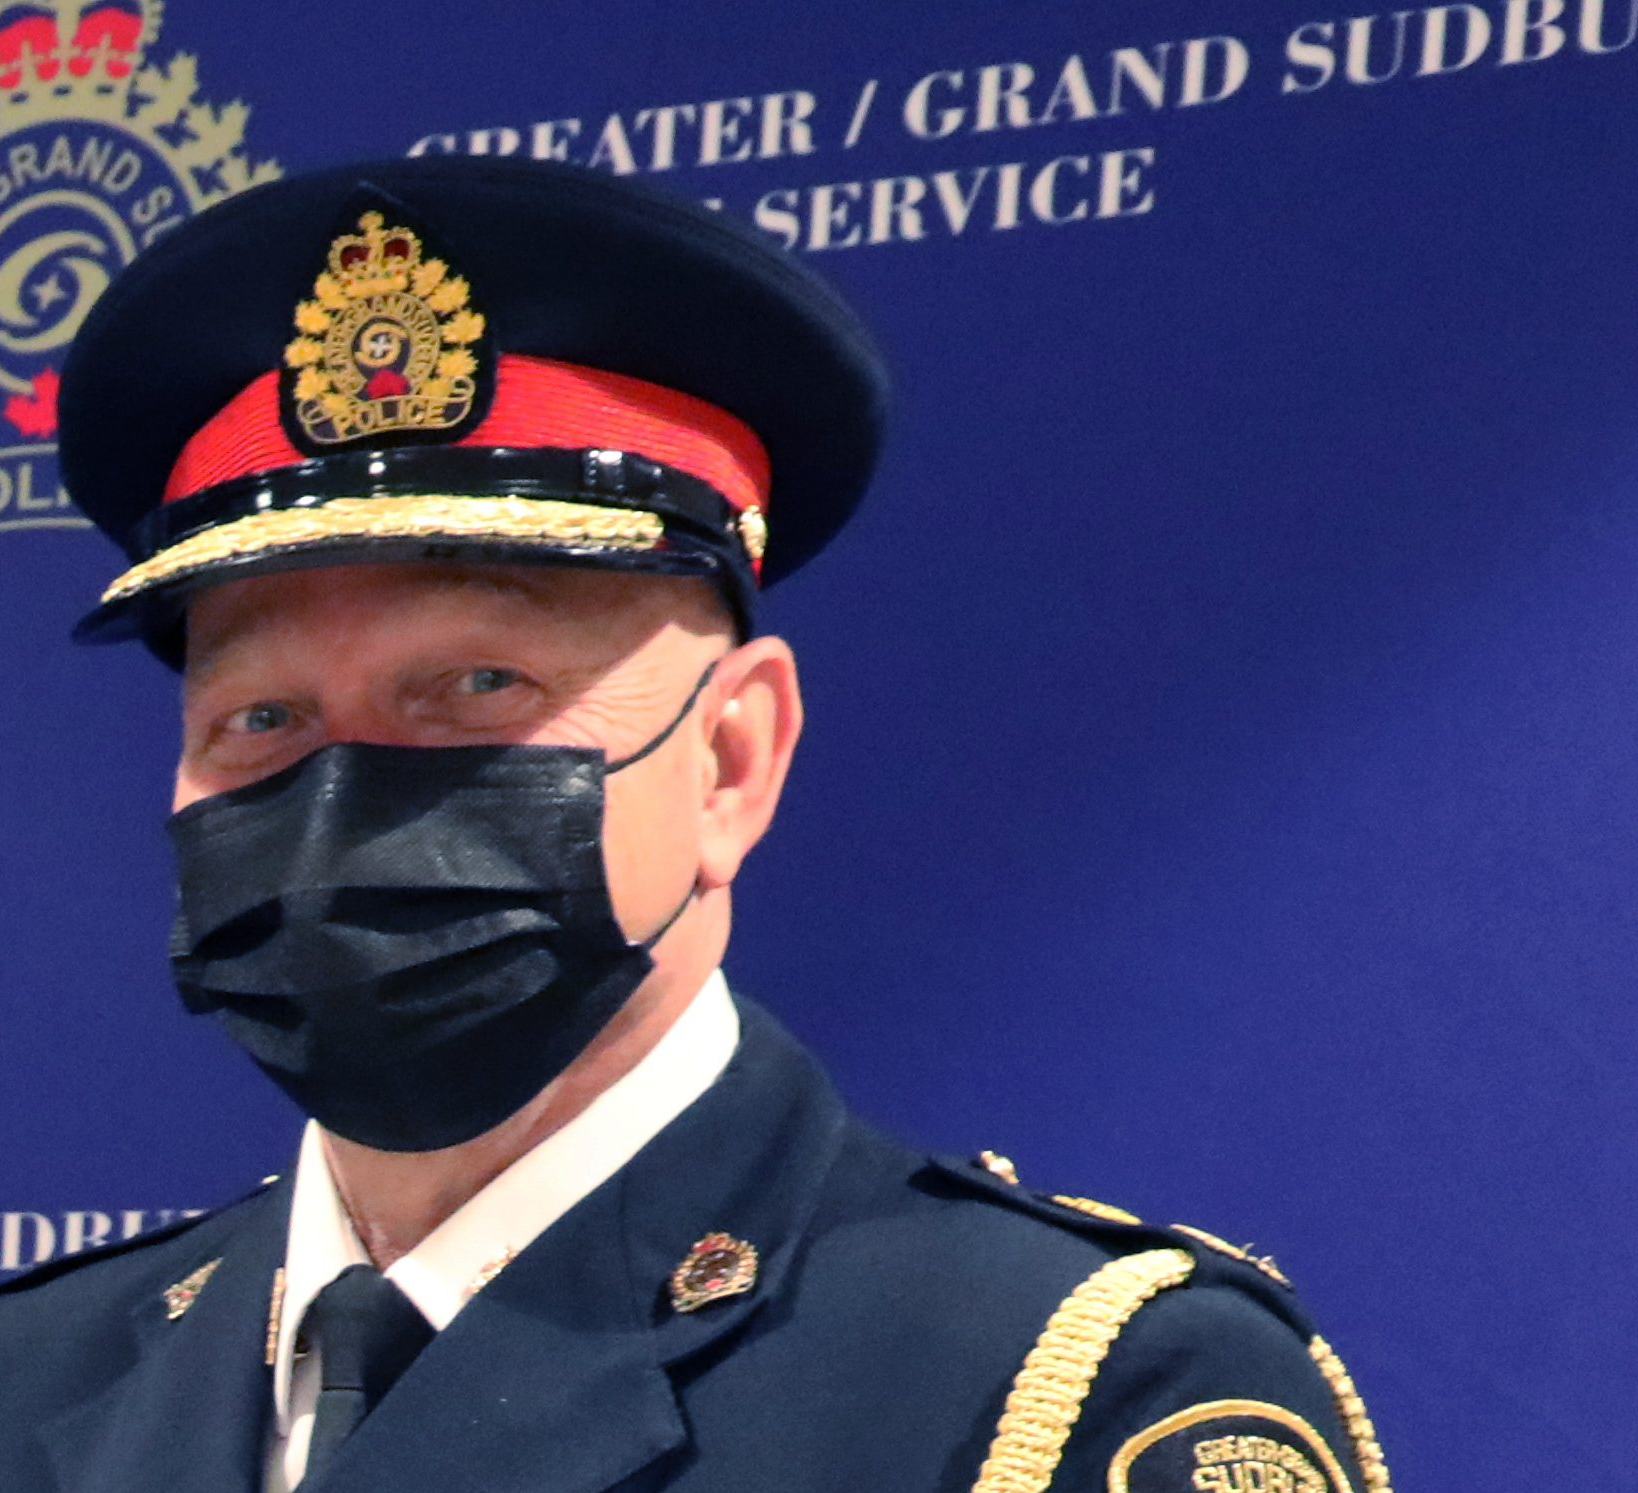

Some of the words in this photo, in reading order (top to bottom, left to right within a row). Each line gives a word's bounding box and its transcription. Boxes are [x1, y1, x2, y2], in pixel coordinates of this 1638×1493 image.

[901, 35, 1251, 140] GRAND
[753, 145, 1155, 252] SERVICE
[336, 399, 446, 433] POLICE
